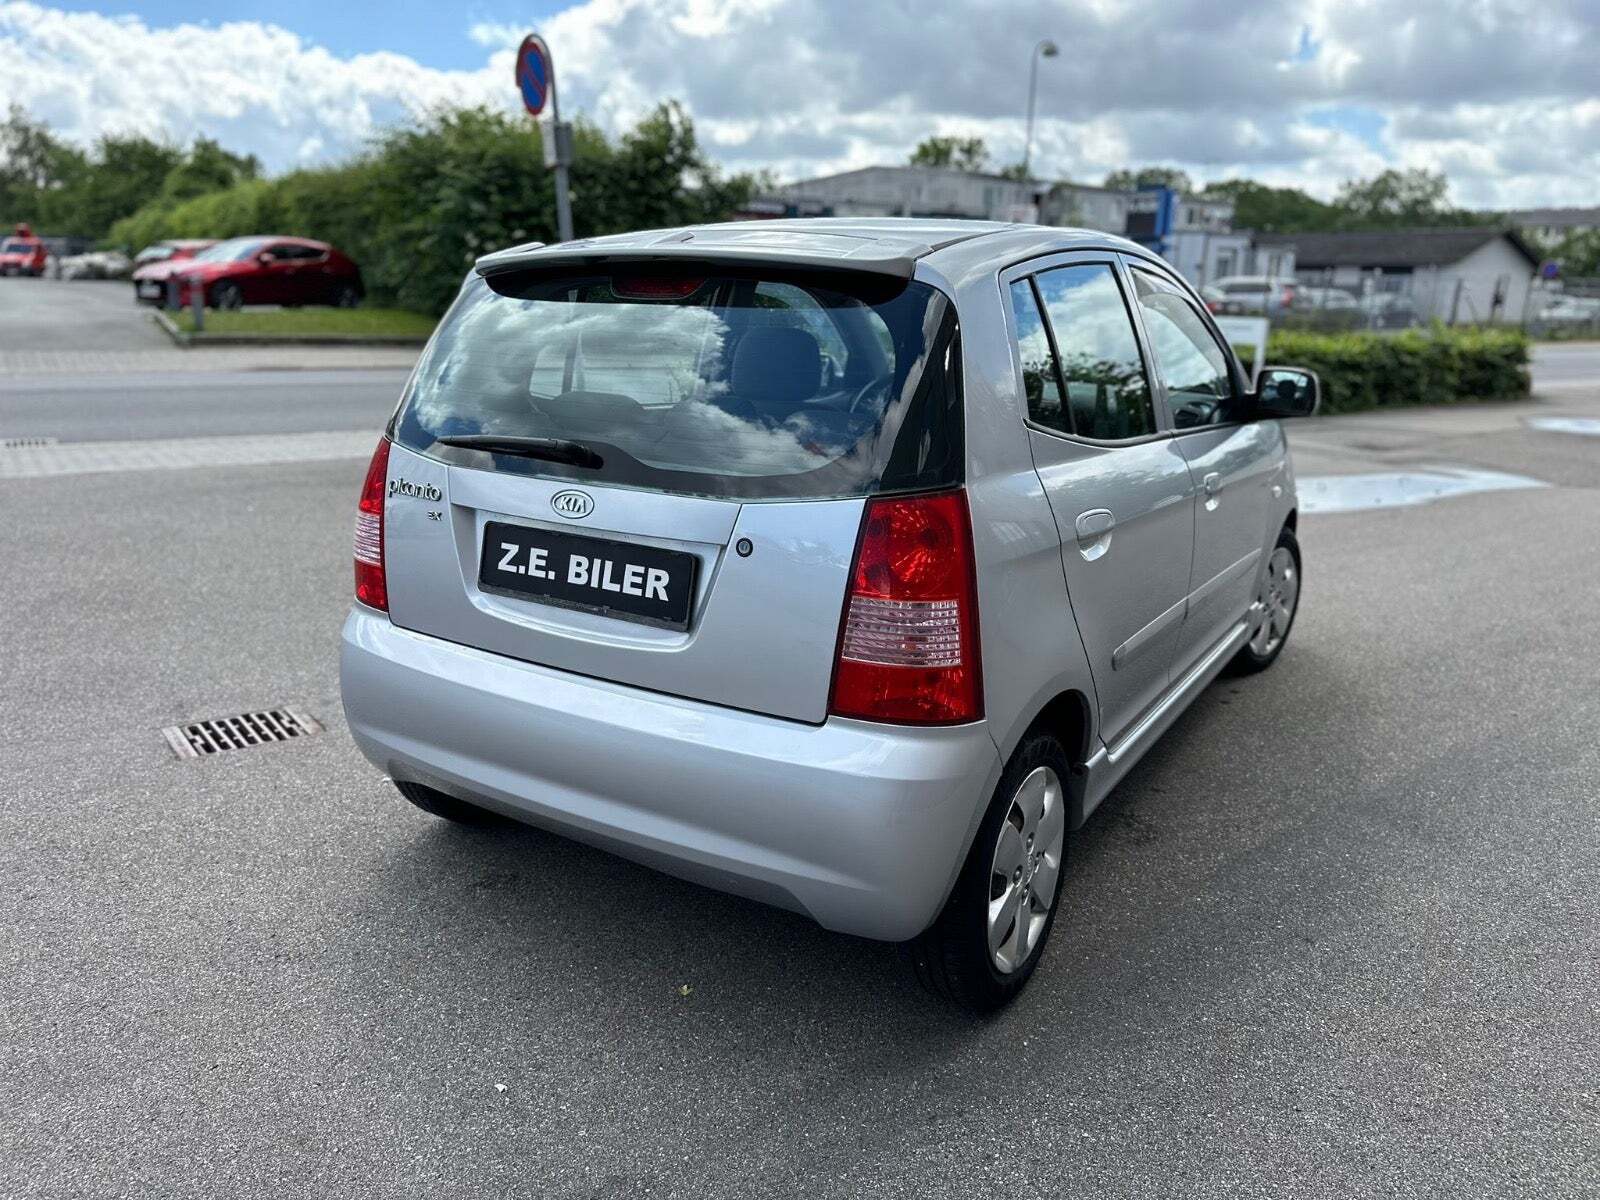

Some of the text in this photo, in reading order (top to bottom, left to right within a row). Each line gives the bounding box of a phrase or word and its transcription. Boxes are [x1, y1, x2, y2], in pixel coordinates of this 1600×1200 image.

[560, 496, 586, 513] KIA
[427, 511, 442, 521] EX
[497, 542, 671, 601] Z.E. BILER
